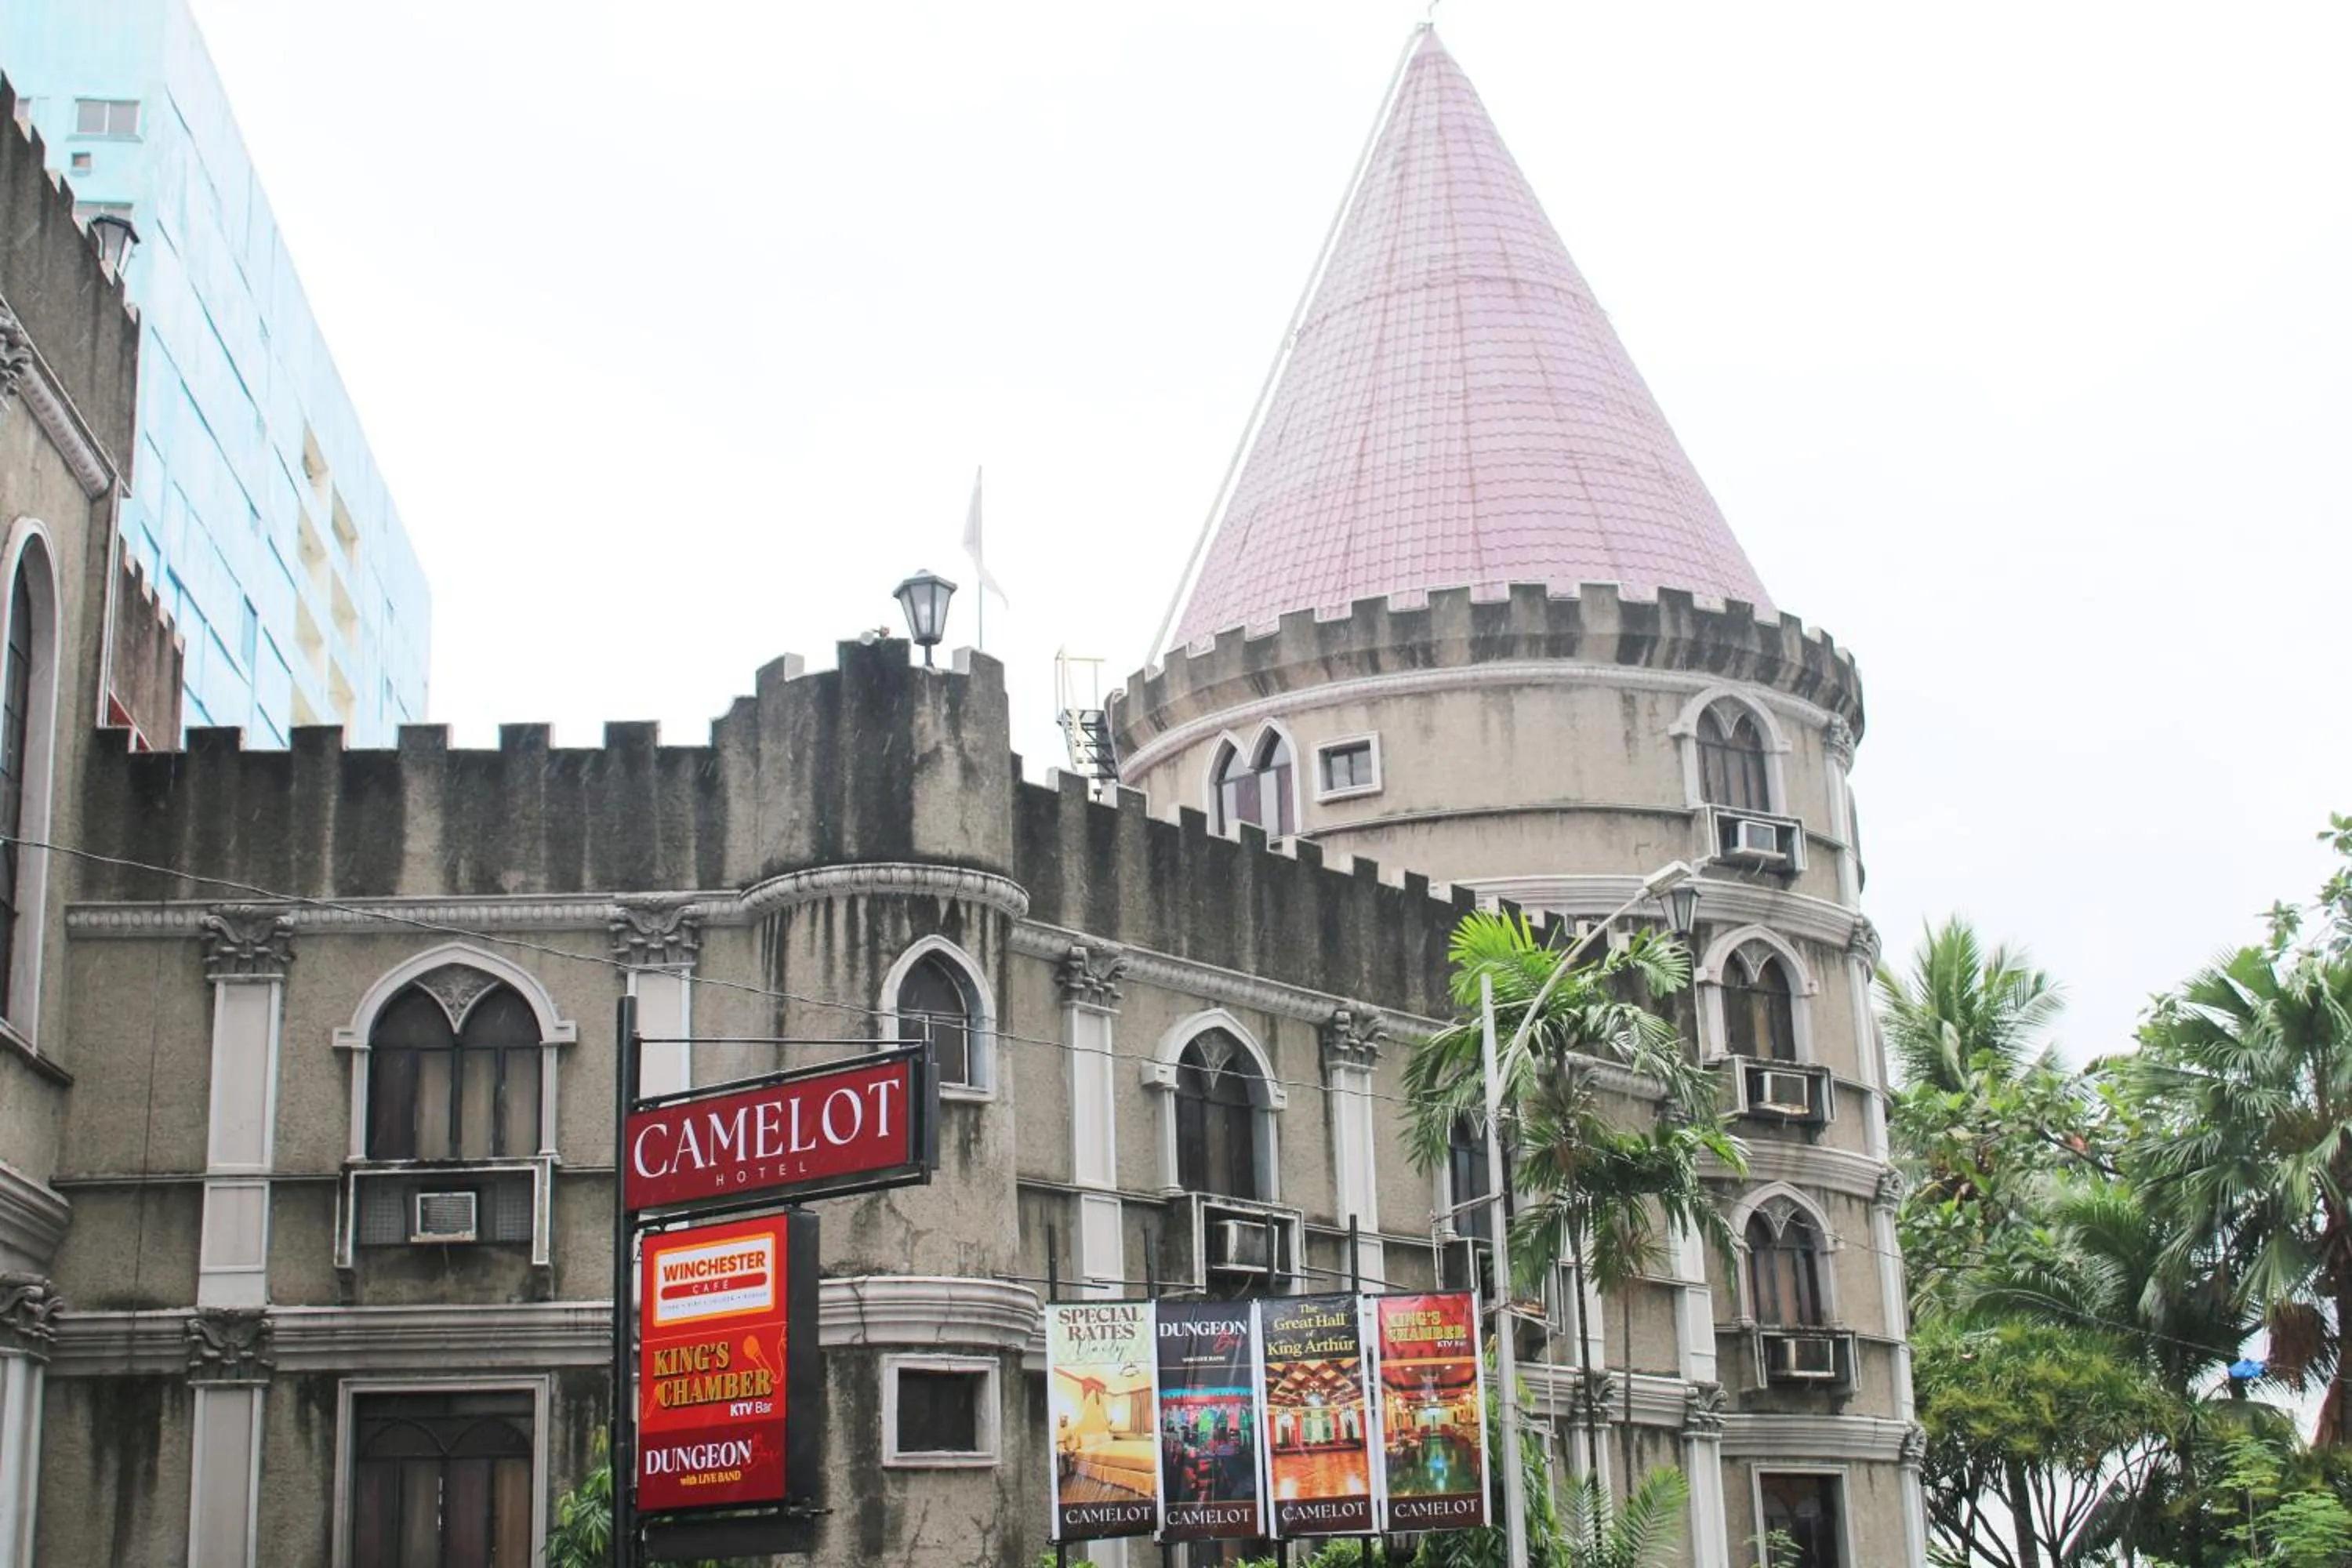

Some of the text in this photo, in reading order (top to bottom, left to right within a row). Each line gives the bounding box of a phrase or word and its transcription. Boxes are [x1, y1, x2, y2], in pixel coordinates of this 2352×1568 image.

[633, 1078, 901, 1178] CAMELOT
[716, 1161, 807, 1186] HOTEL
[663, 1250, 766, 1282] WINCHESTER
[1058, 1306, 1143, 1324] SPECIAL
[1298, 1304, 1318, 1314] The
[1160, 1320, 1247, 1337] DUNGEON
[1274, 1312, 1346, 1330] Great Hall
[1069, 1323, 1135, 1341] RATES
[1267, 1337, 1355, 1357] King Arthur
[653, 1341, 729, 1377] KING'S
[659, 1368, 772, 1408] CHAMBER
[730, 1401, 772, 1417] KTV Bar
[645, 1439, 752, 1475] DUNGEON
[680, 1470, 741, 1486] with LIVE BAND
[1065, 1506, 1151, 1524] CAMELOT
[1167, 1508, 1251, 1526] CAMELOT
[1282, 1501, 1365, 1520] CAMELOT
[1395, 1499, 1478, 1518] CAMELOT
